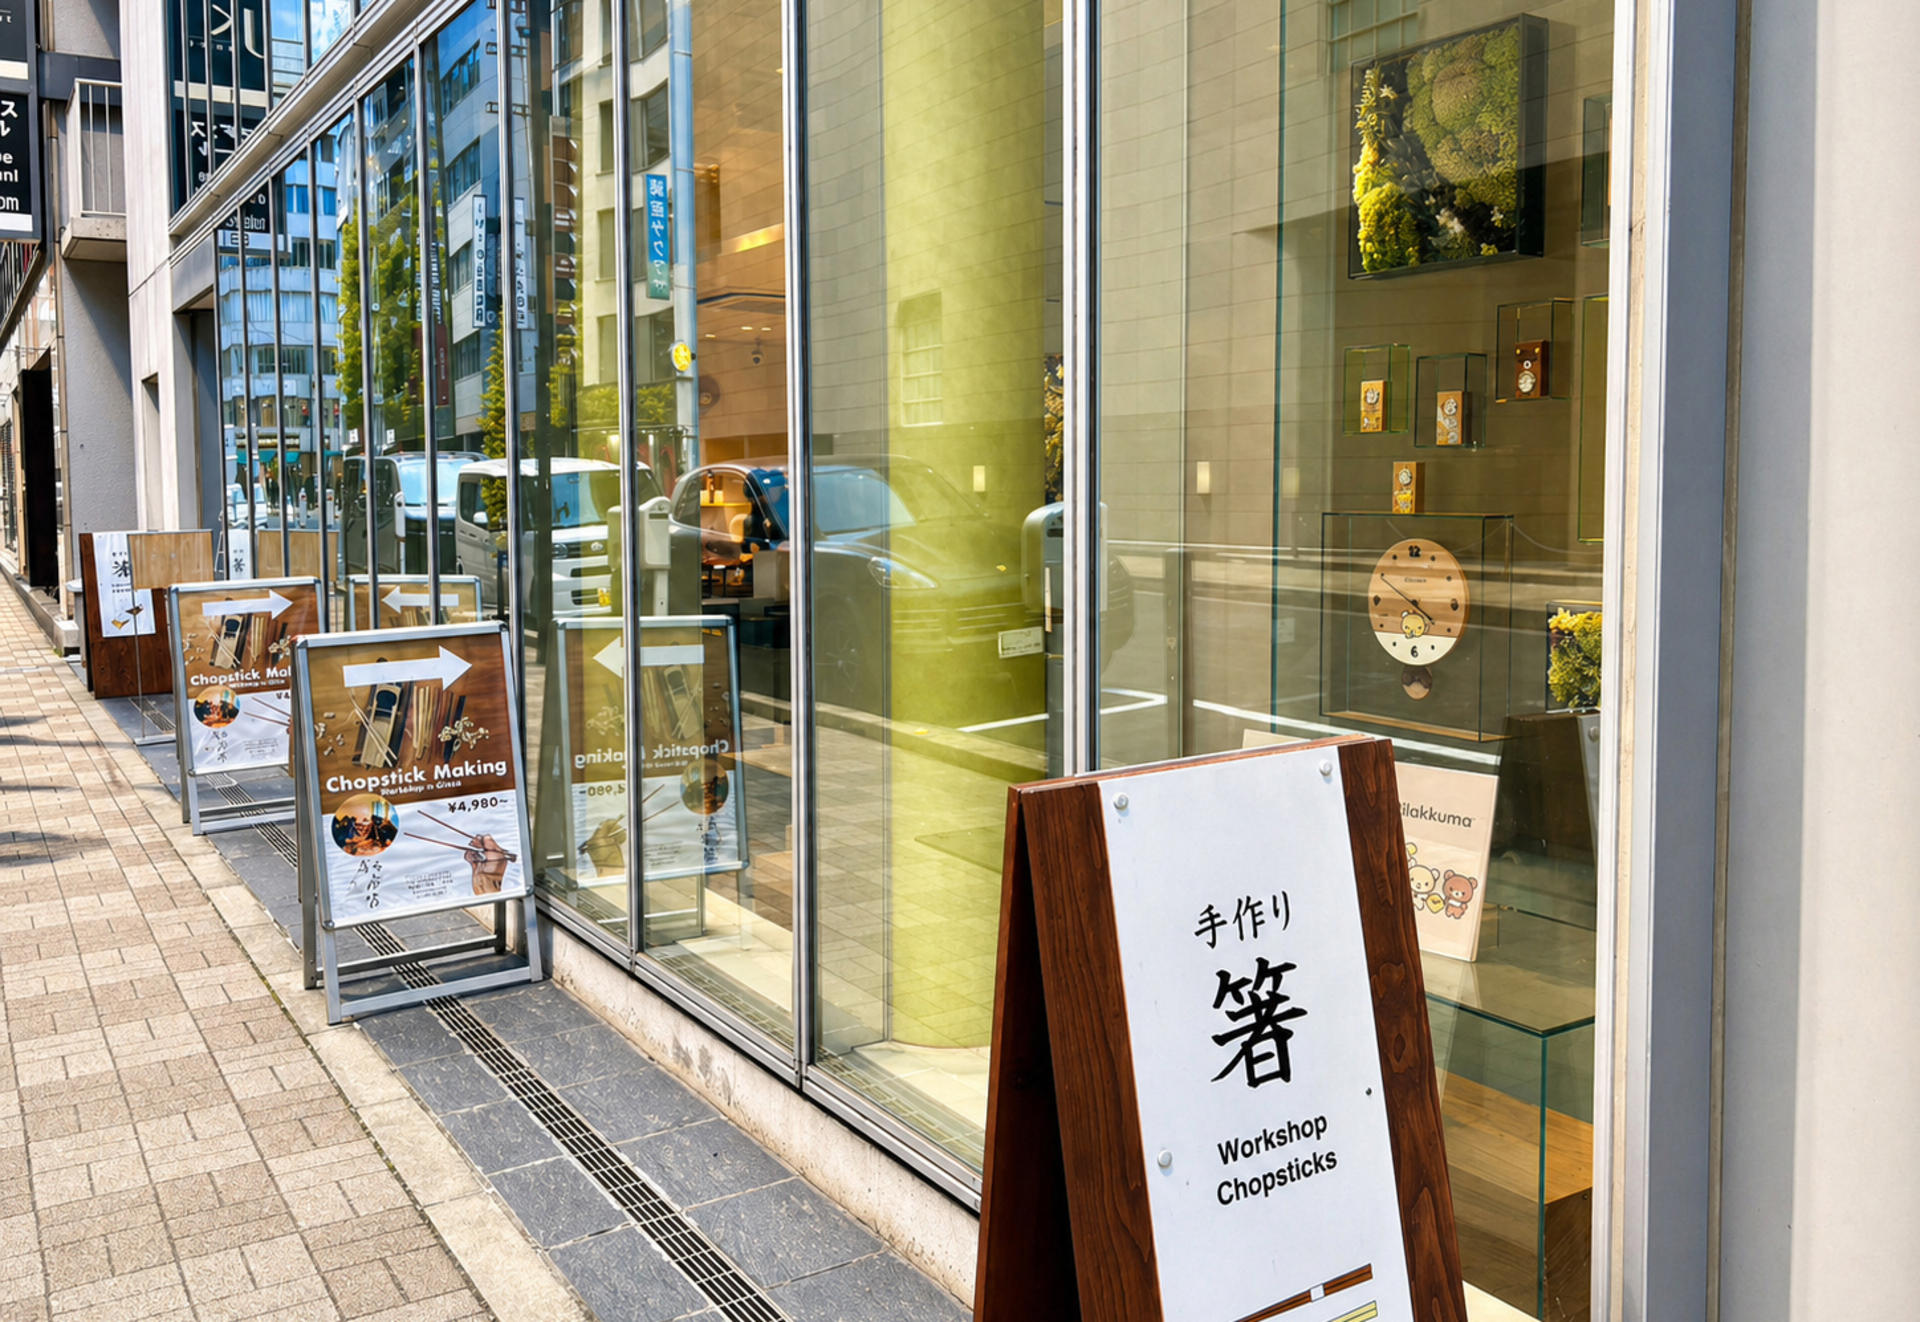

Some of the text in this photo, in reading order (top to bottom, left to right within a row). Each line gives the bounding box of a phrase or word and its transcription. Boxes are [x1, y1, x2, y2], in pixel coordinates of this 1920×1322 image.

[1408, 545, 1421, 558] 12
[1411, 645, 1418, 658] 6
[190, 668, 261, 686] Chopstick
[266, 665, 292, 679] Ma
[326, 760, 507, 794] Chopstick Making
[1400, 802, 1472, 828] ilakkuma
[1194, 890, 1291, 949] 手作り
[1210, 956, 1308, 1089] 箸
[1217, 1114, 1328, 1166] Workshop
[1217, 1147, 1338, 1206] Chopsticks
